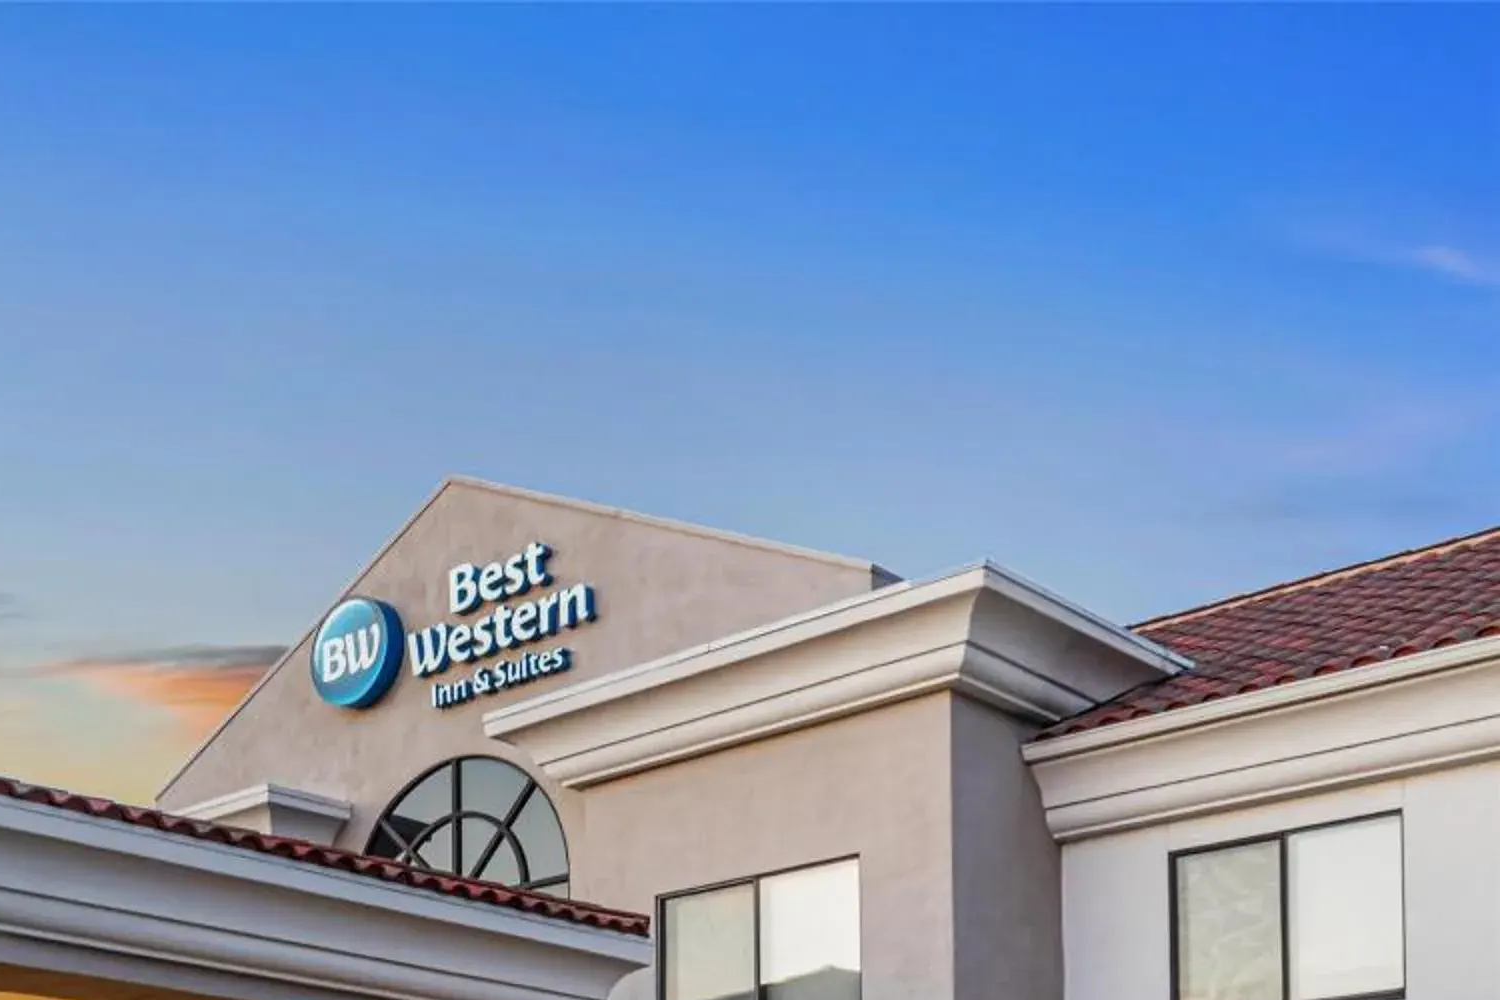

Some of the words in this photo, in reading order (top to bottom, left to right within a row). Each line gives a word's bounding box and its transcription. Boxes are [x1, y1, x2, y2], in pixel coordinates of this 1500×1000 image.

[449, 542, 548, 614] Best
[322, 623, 382, 684] BW
[407, 582, 594, 678] Western
[431, 671, 471, 709] Inn
[473, 666, 493, 694] &
[494, 646, 568, 688] Suites
